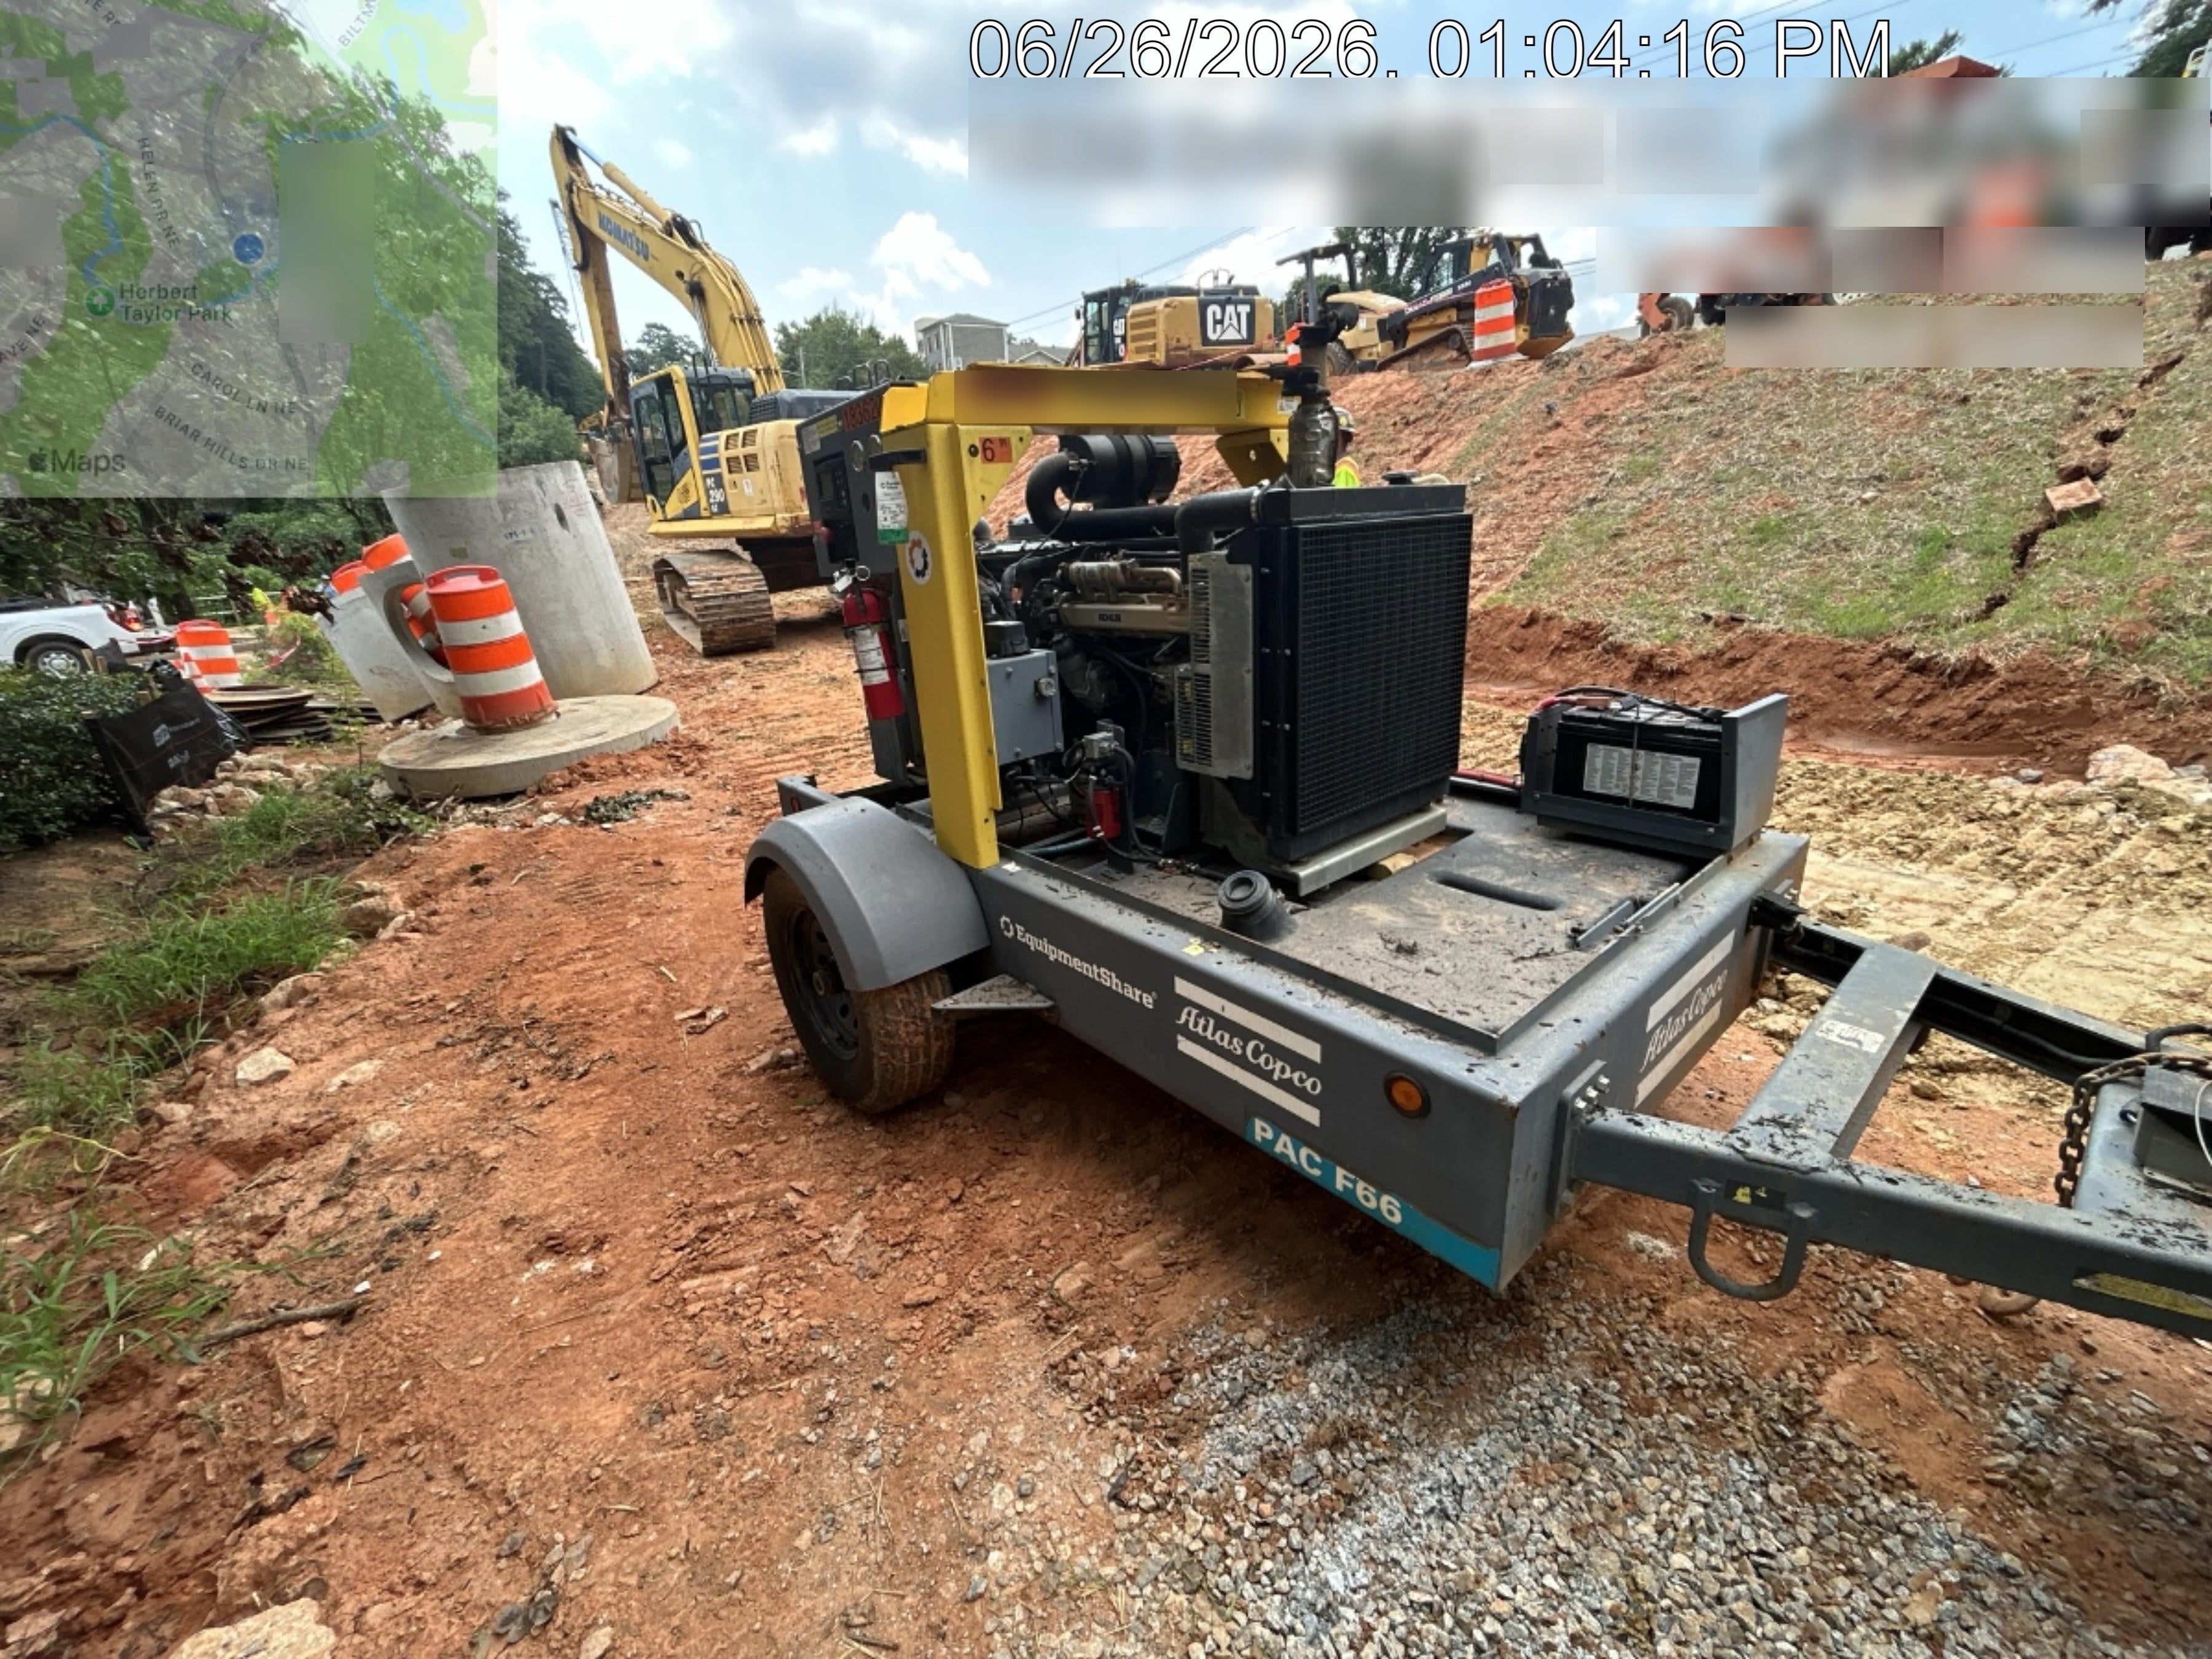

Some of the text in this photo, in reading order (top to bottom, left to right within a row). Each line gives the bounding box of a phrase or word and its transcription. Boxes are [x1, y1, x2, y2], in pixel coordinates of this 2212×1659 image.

[1206, 304, 1251, 340] CAT
[1175, 1005, 1322, 1096] Atlas Copco
[1639, 1005, 1690, 1073] Atlas
[1253, 1118, 1403, 1225] PAC F66
